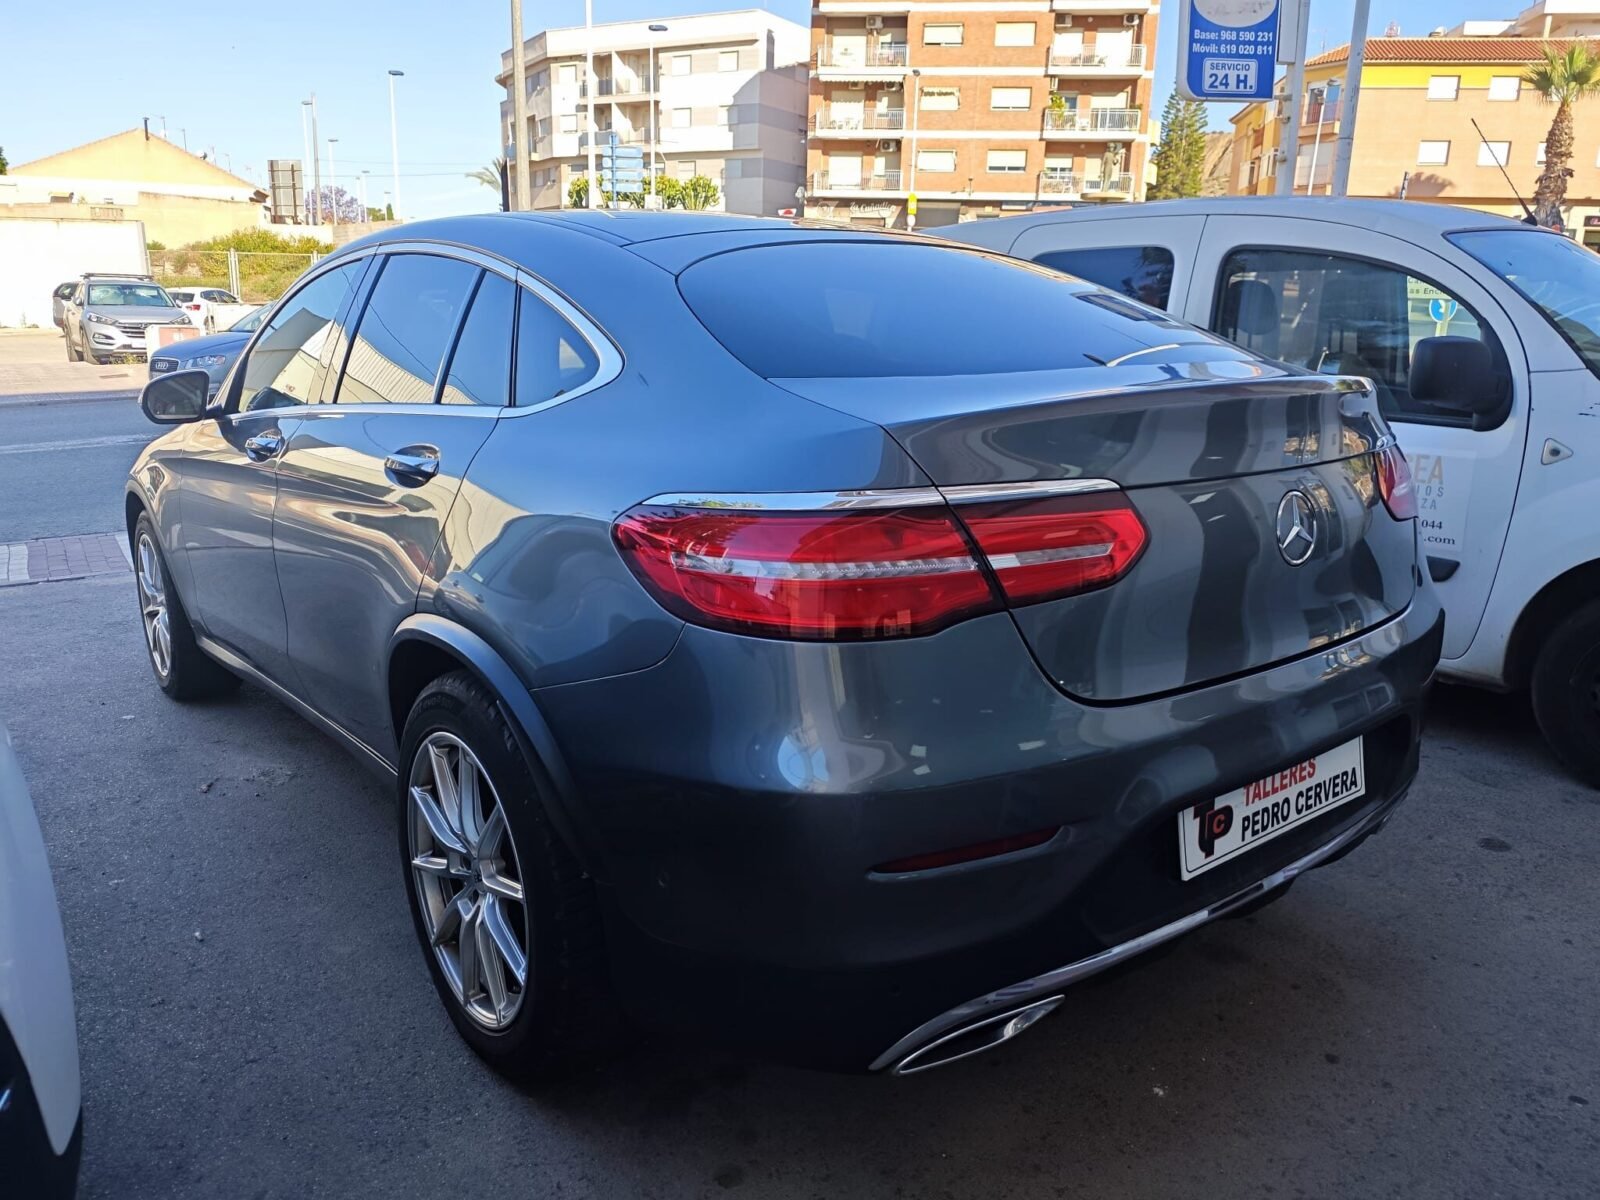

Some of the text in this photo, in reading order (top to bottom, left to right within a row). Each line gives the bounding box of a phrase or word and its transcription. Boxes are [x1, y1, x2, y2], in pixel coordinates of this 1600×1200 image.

[1194, 29, 1273, 42] Base: 968 590 231
[1192, 42, 1273, 55] Móvil: 619 020 811
[1210, 62, 1251, 72] SERVICIO
[1208, 73, 1253, 90] 24 H.
[1244, 757, 1317, 807] TALLERES
[1241, 767, 1358, 843] PEDRO CERVERA
